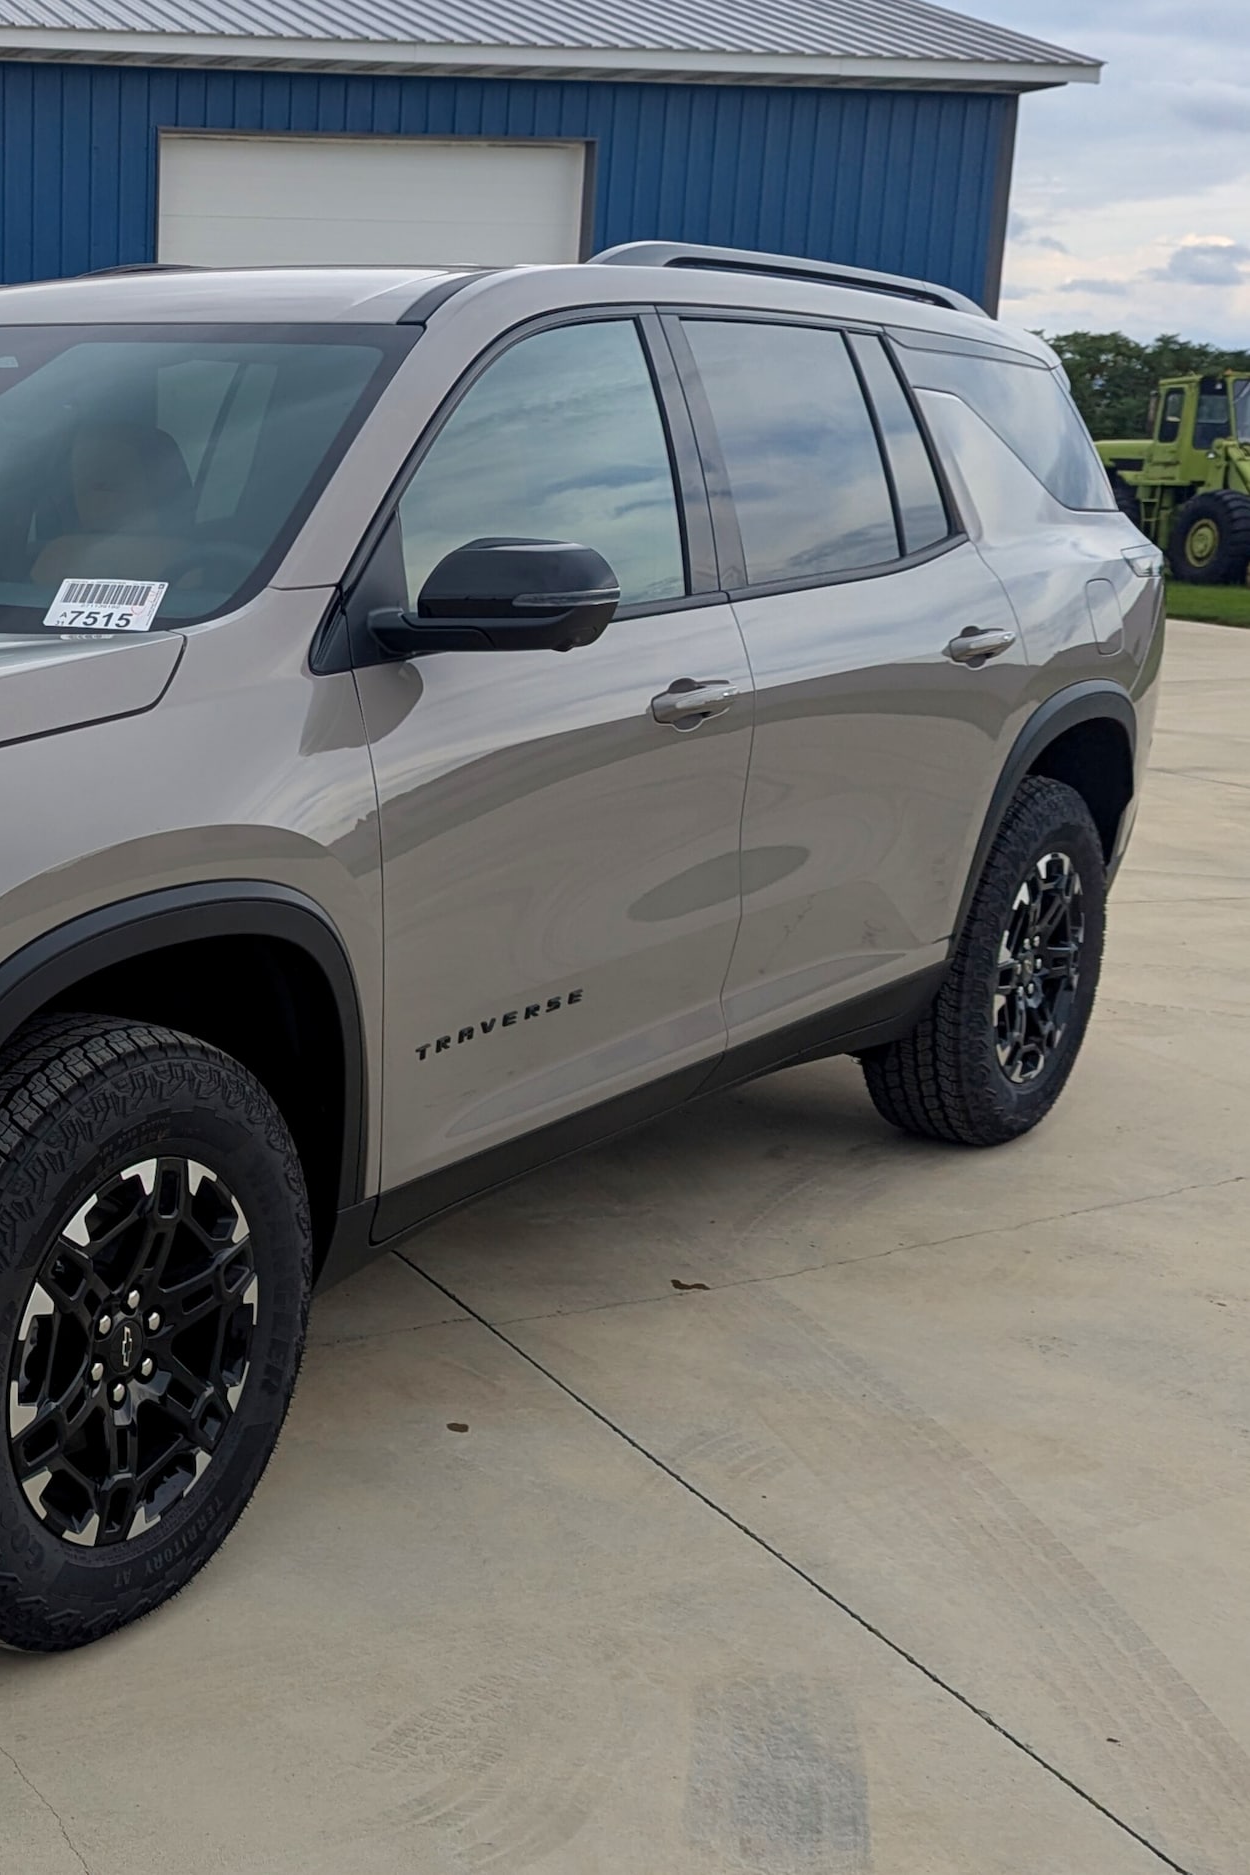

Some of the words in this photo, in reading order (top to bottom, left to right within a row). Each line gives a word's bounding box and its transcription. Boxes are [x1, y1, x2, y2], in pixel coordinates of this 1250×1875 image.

[68, 610, 133, 628] 7515
[415, 989, 583, 1061] TRAVERSE
[144, 1496, 223, 1578] TERRITORY
[112, 1567, 133, 1588] AT
